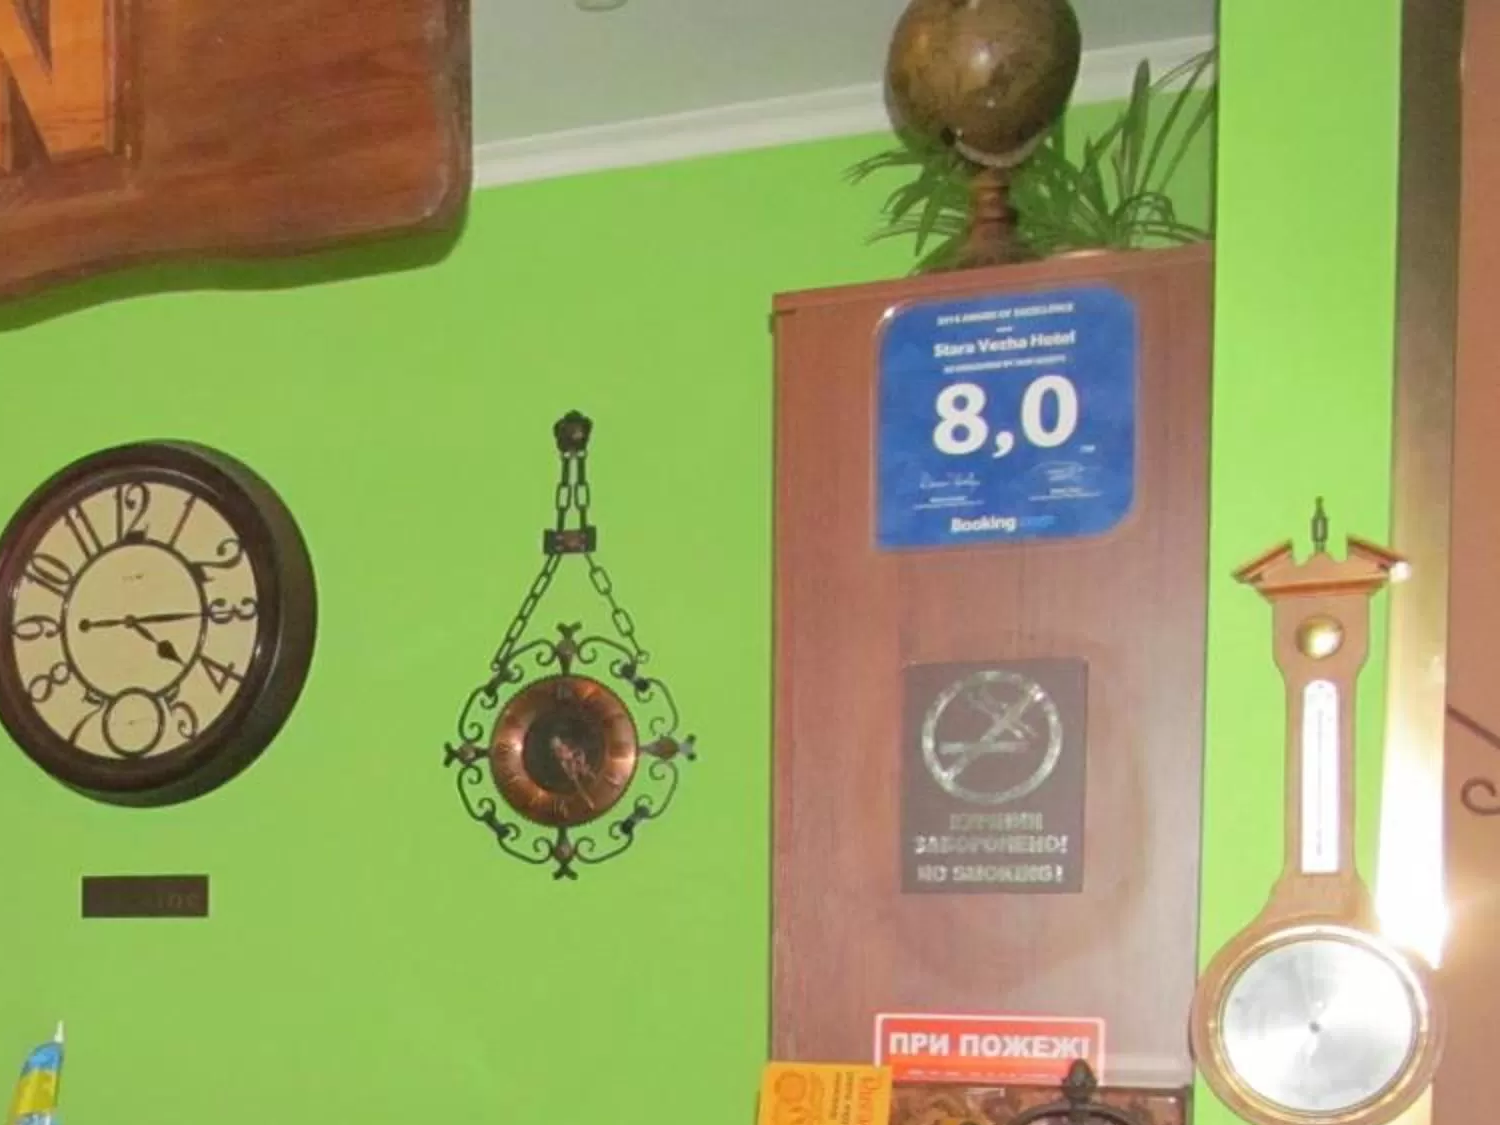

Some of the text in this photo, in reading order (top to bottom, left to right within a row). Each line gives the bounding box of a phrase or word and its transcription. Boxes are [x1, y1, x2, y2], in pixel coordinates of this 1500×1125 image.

[1030, 328, 1077, 348] Hotel
[932, 374, 1079, 458] 8,0
[64, 501, 104, 561] 11
[112, 482, 152, 542] 12
[949, 513, 1056, 534] Booking
[22, 553, 78, 598] 10
[189, 538, 242, 583] 2
[208, 597, 259, 624] 3
[28, 661, 70, 703] 8
[198, 654, 245, 694] 4
[67, 687, 105, 745] 7
[162, 682, 199, 742] 5
[888, 1031, 1091, 1059] ПРИ ПОЖЕЖІ
